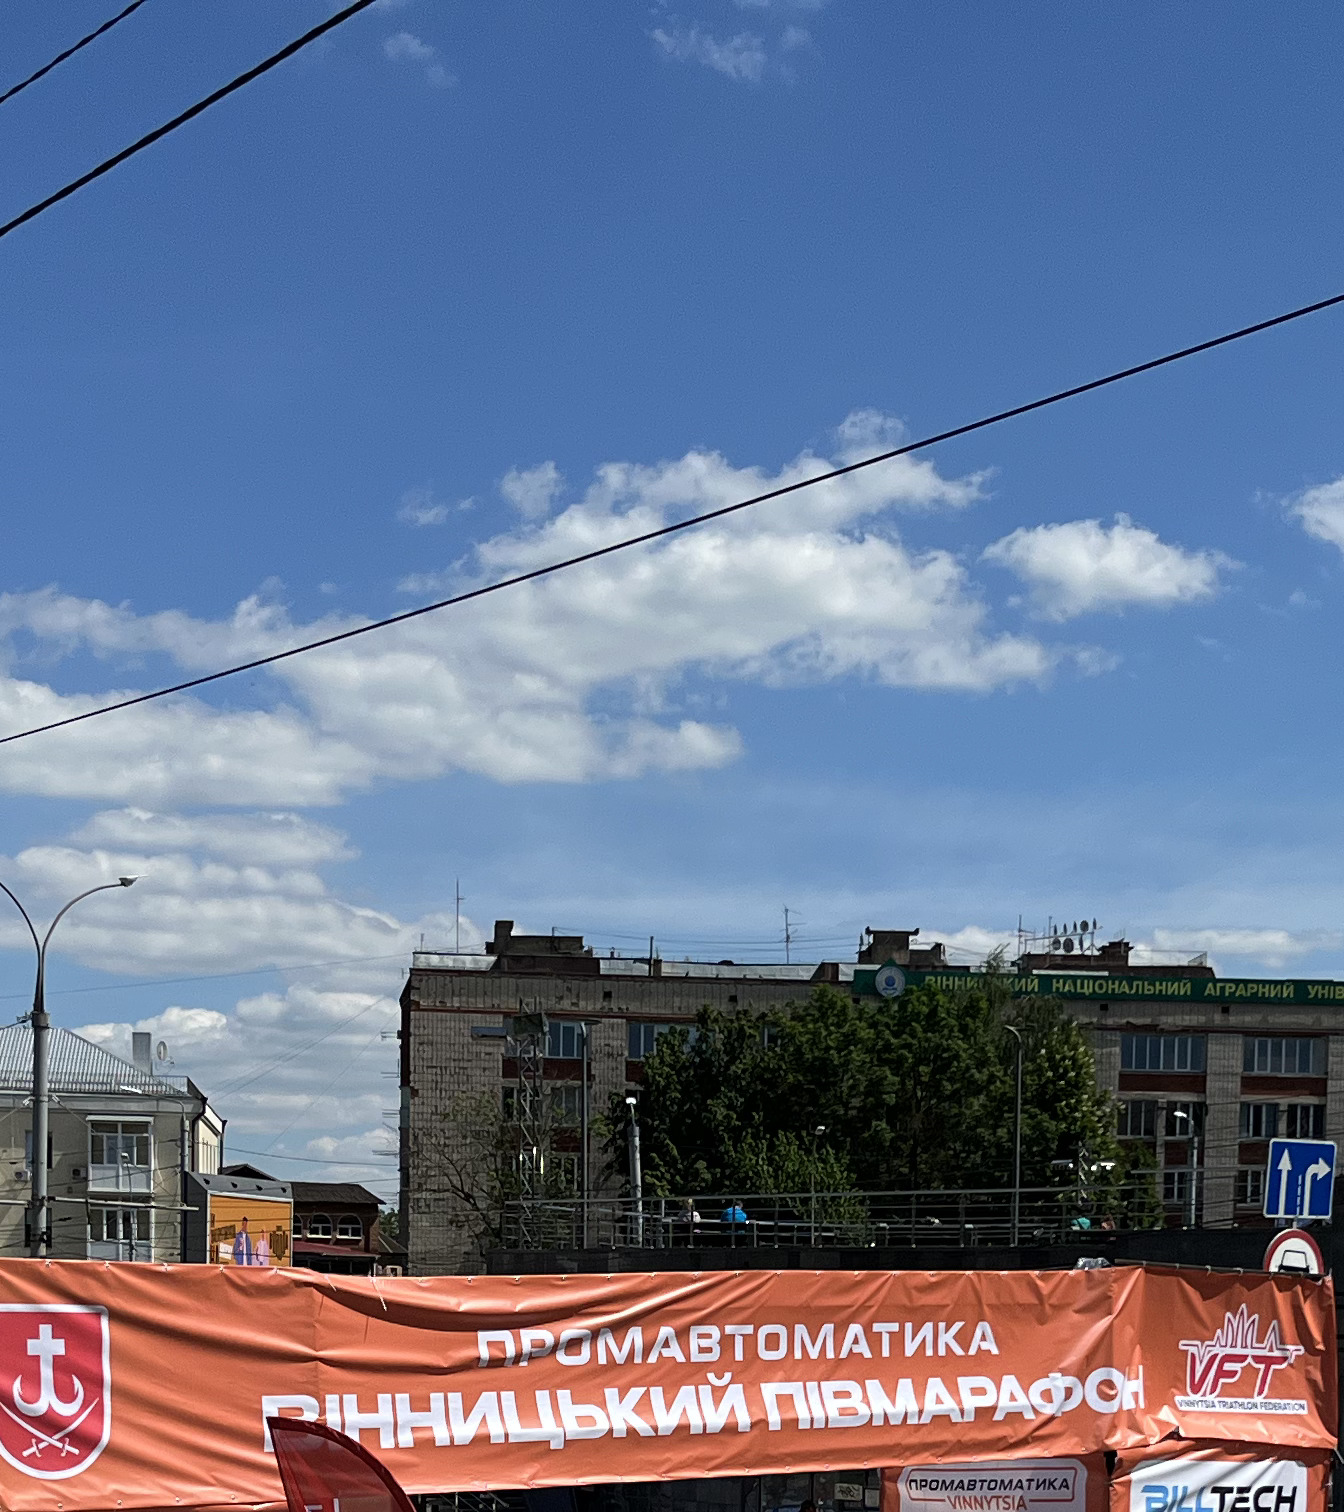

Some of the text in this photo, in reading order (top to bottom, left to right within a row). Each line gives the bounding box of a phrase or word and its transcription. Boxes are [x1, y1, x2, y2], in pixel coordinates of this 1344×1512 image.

[1052, 978, 1191, 997] НАЦІОНАЛЬНИЙ
[1204, 981, 1294, 998] АГРАРНИЙ
[477, 1321, 1000, 1368] ПРОМАВТОМАТИКА
[1186, 1350, 1290, 1400] VFT
[762, 1364, 1146, 1432] ПІВМАРАФОН
[1218, 1400, 1258, 1411] TRIATHLON
[1260, 1401, 1306, 1412] FEDERATION
[909, 1478, 1070, 1491] ПРОМАВТОМАТИКА
[947, 1495, 1027, 1511] VINNYTSIA
